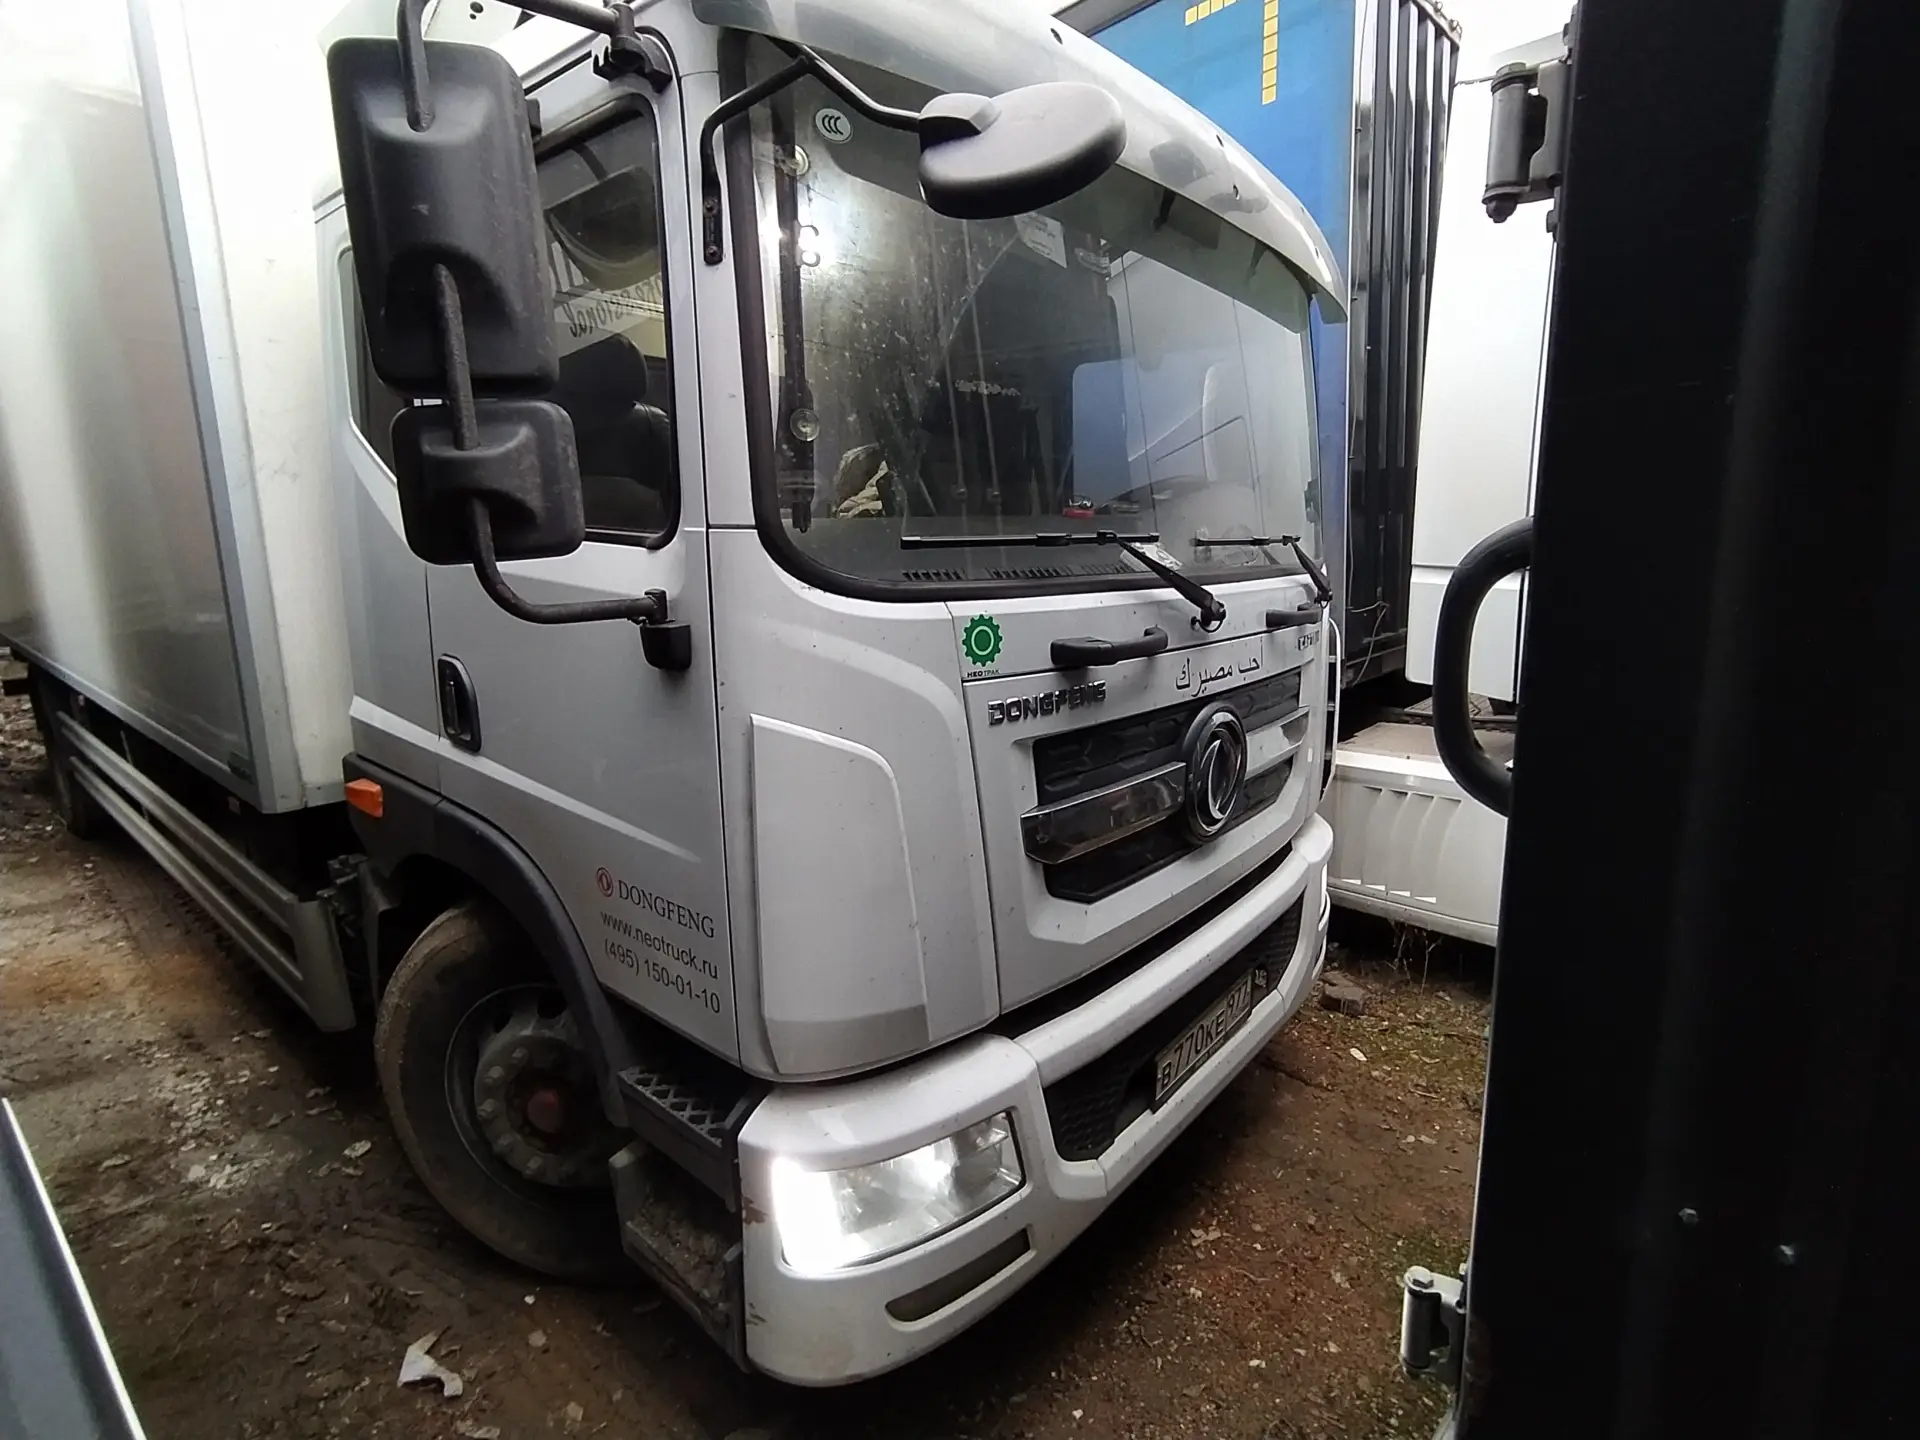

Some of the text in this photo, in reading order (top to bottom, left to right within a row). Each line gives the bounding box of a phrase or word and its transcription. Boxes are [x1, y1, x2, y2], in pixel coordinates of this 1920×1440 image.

[987, 680, 1106, 725] DONGFENG
[1175, 657, 1233, 697] مصيرك
[617, 879, 715, 938] DONGFENG
[600, 911, 719, 980] www.neotruck.ru
[604, 938, 721, 1014] (495) 150-01-10
